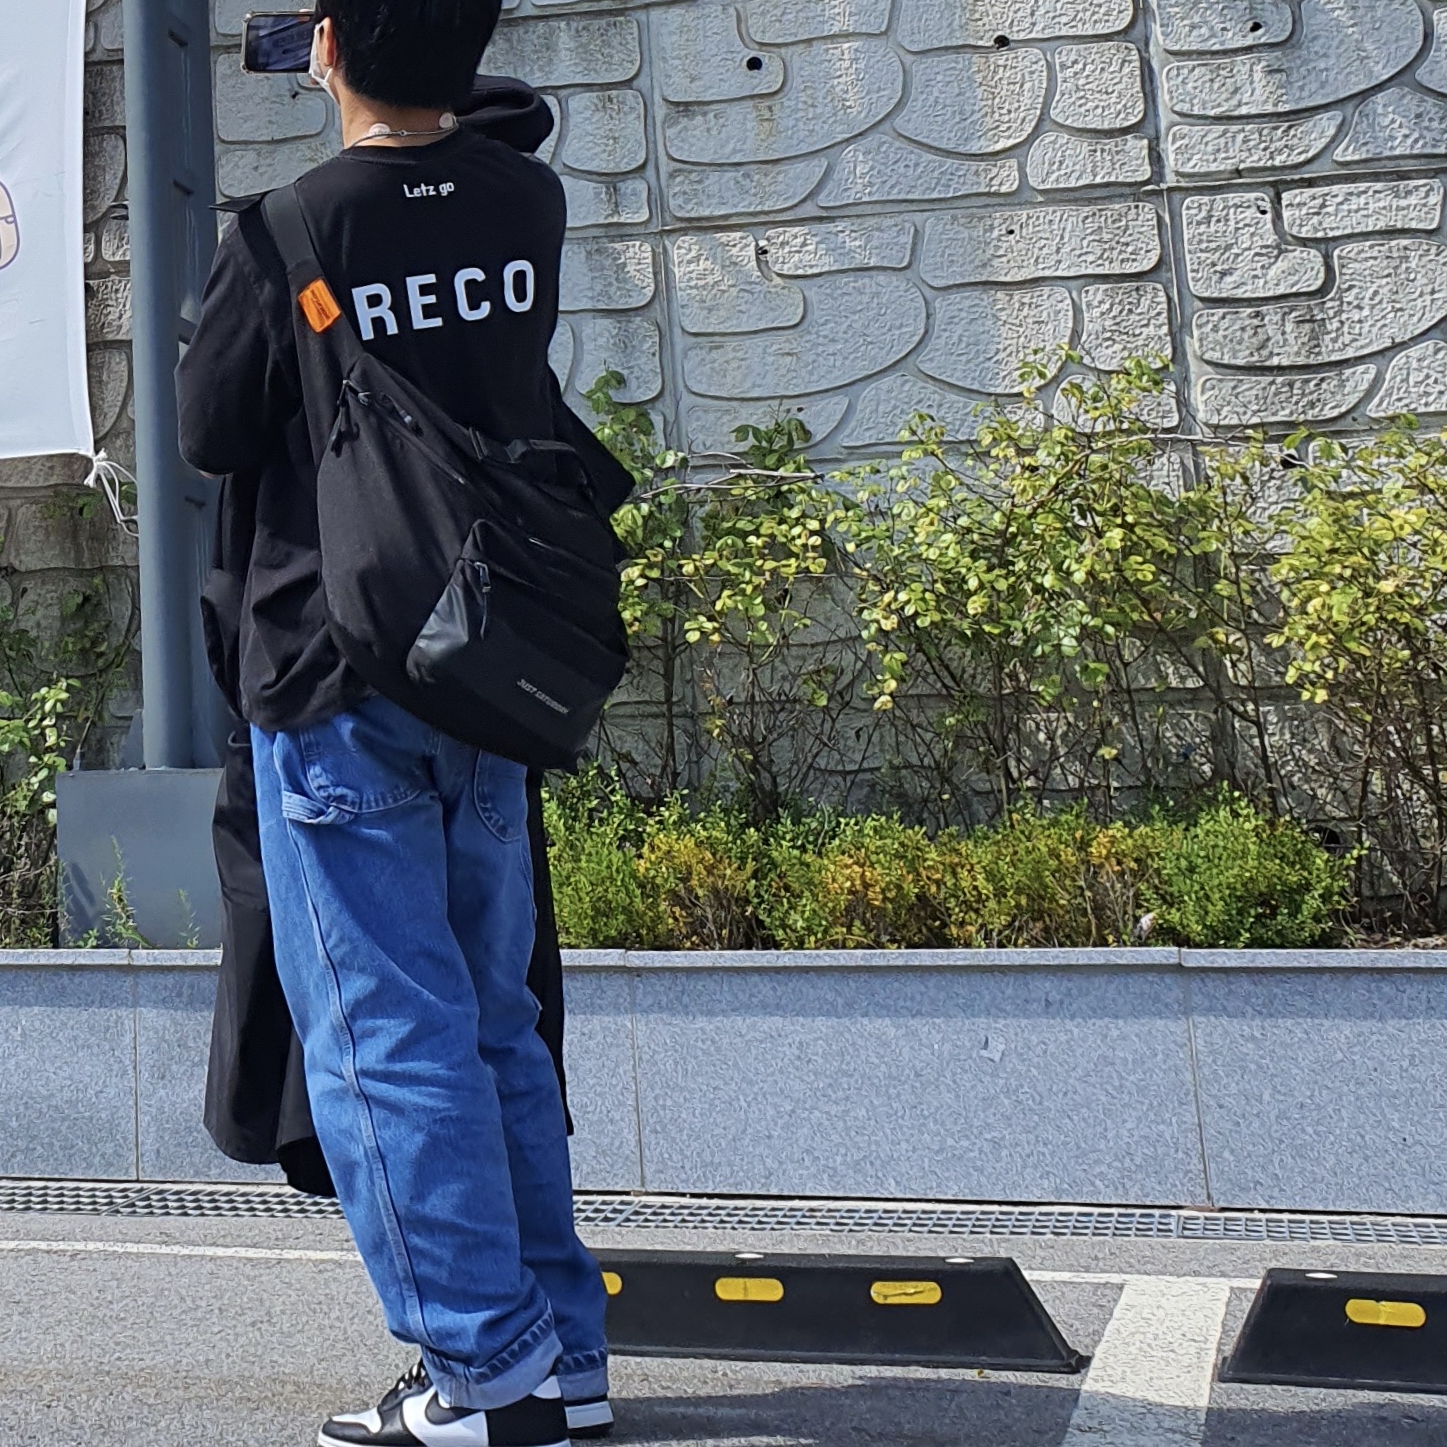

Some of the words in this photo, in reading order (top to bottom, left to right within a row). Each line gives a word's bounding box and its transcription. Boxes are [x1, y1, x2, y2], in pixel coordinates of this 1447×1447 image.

[403, 183, 436, 198] Letz
[439, 180, 455, 197] go
[351, 258, 536, 342] RECO
